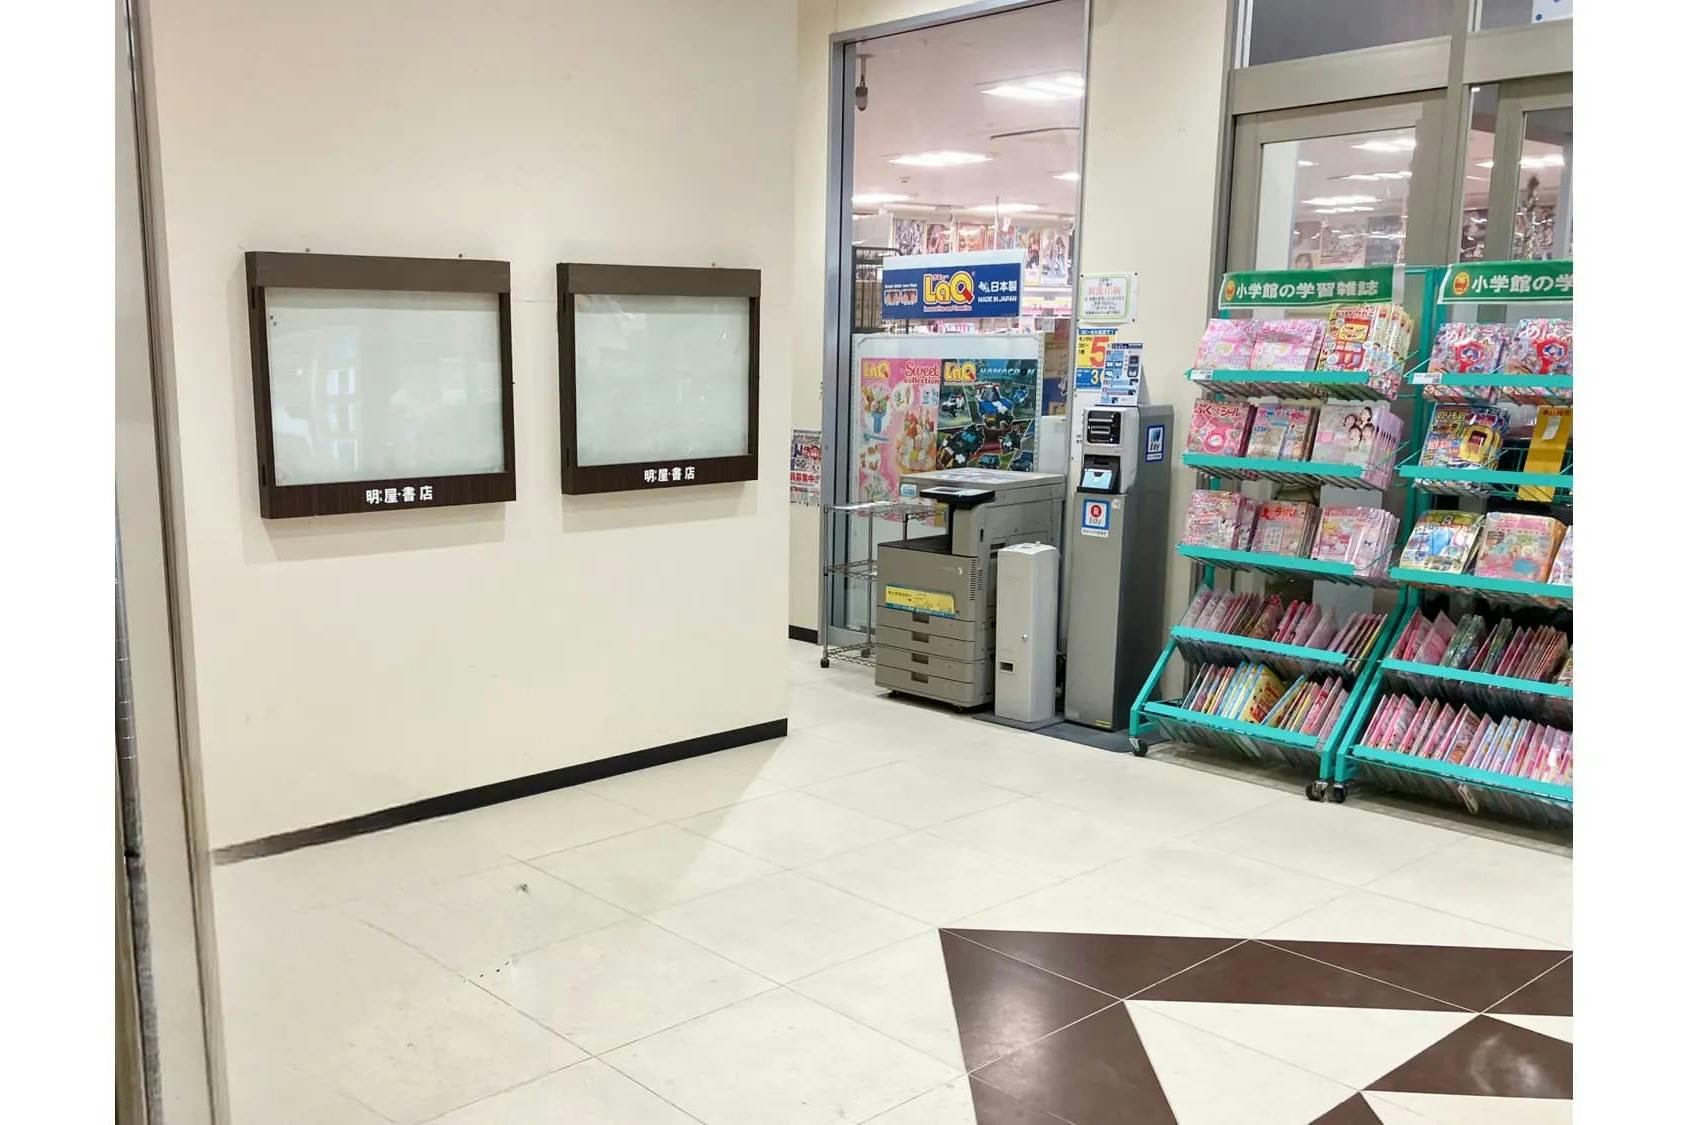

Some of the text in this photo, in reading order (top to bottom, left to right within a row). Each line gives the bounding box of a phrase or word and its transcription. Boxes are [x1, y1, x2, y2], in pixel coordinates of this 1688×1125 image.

[923, 270, 975, 305] LaQ
[1236, 280, 1379, 299] 小学館の学習雑誌
[1471, 274, 1573, 293] 小学館の学
[1089, 336, 1110, 367] 5
[863, 360, 890, 379] LaQ
[904, 361, 940, 377] Sweet
[943, 361, 977, 382] LaQ
[1149, 441, 1161, 452] Edy
